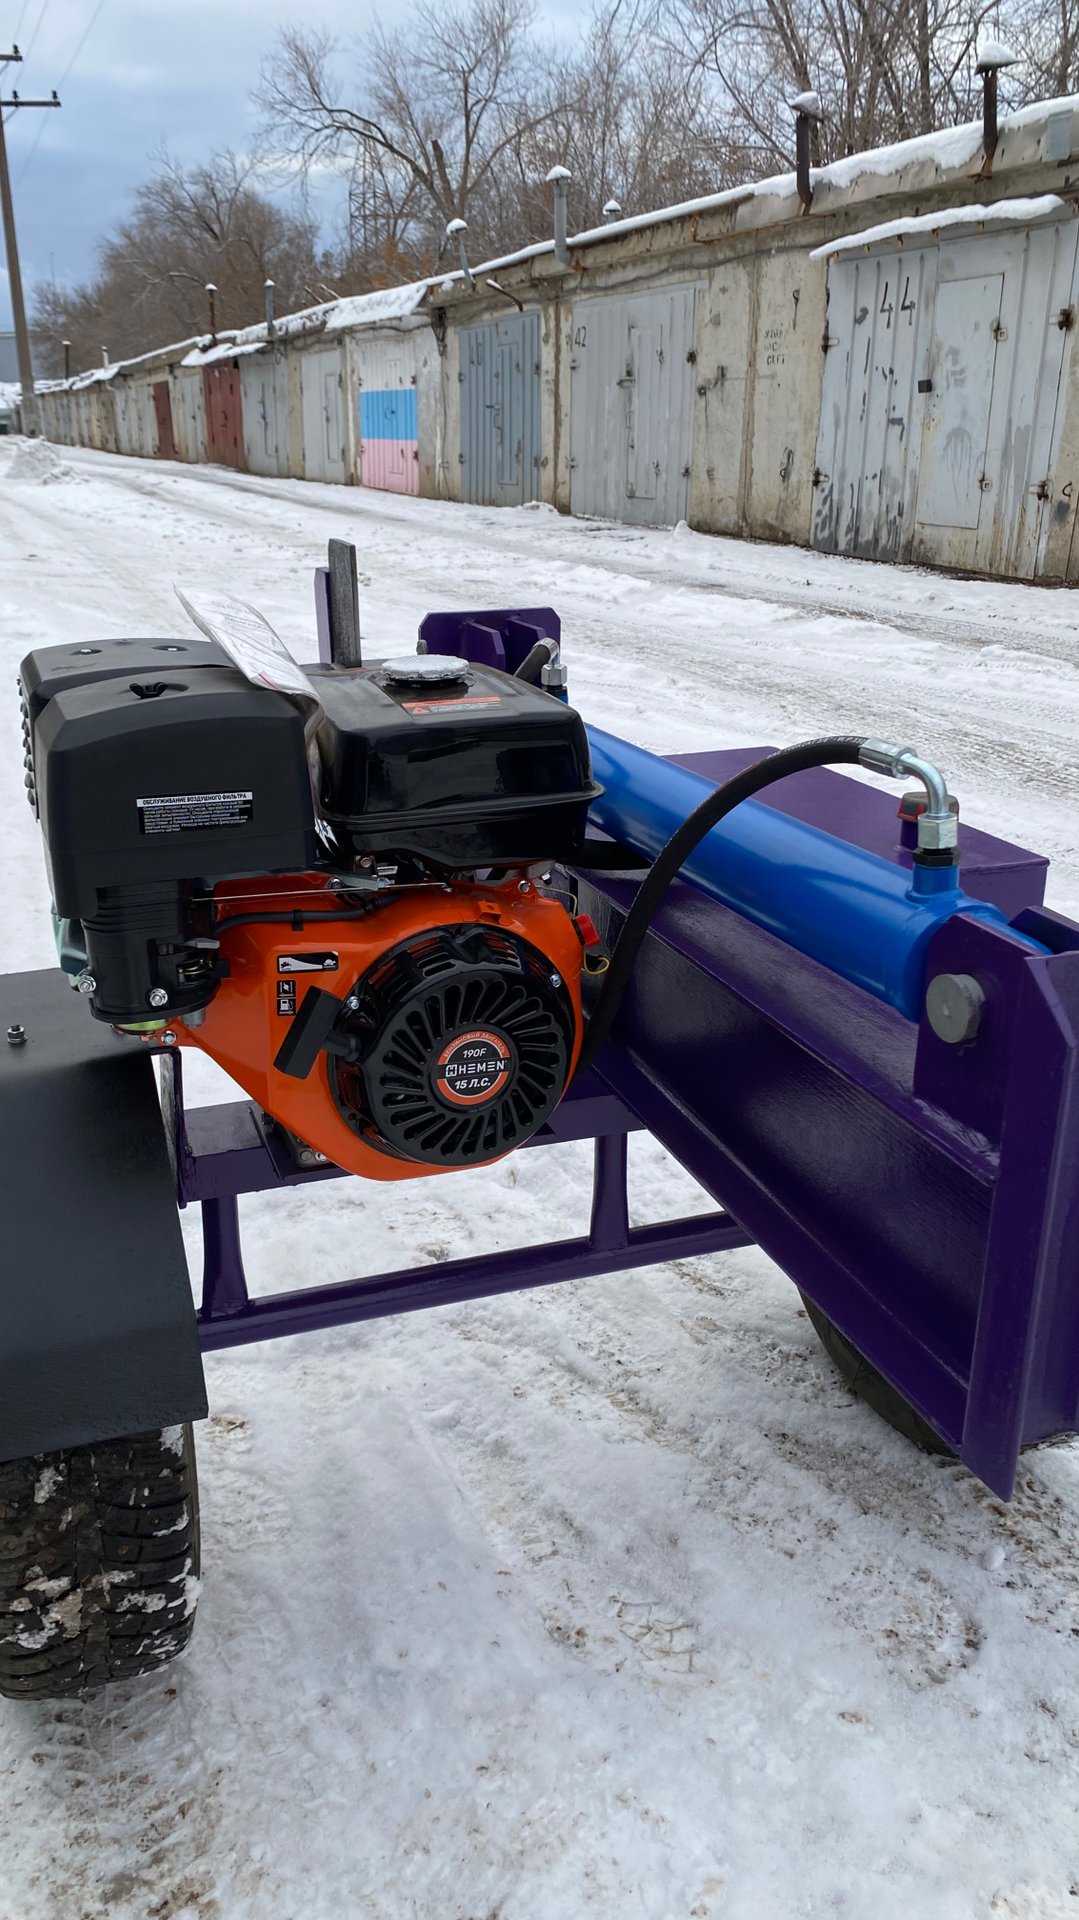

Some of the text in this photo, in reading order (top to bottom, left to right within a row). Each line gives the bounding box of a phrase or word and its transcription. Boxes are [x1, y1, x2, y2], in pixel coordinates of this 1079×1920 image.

[880, 276, 916, 329] 44
[574, 326, 587, 349] 42
[143, 797, 186, 805] ОБСЛУЖИВАНИЕ
[186, 795, 222, 803] ВОЗДУШНОГО
[463, 1048, 487, 1058] 190F
[458, 1060, 505, 1074] HEMEN
[455, 1077, 491, 1090] 15 Л.С.
